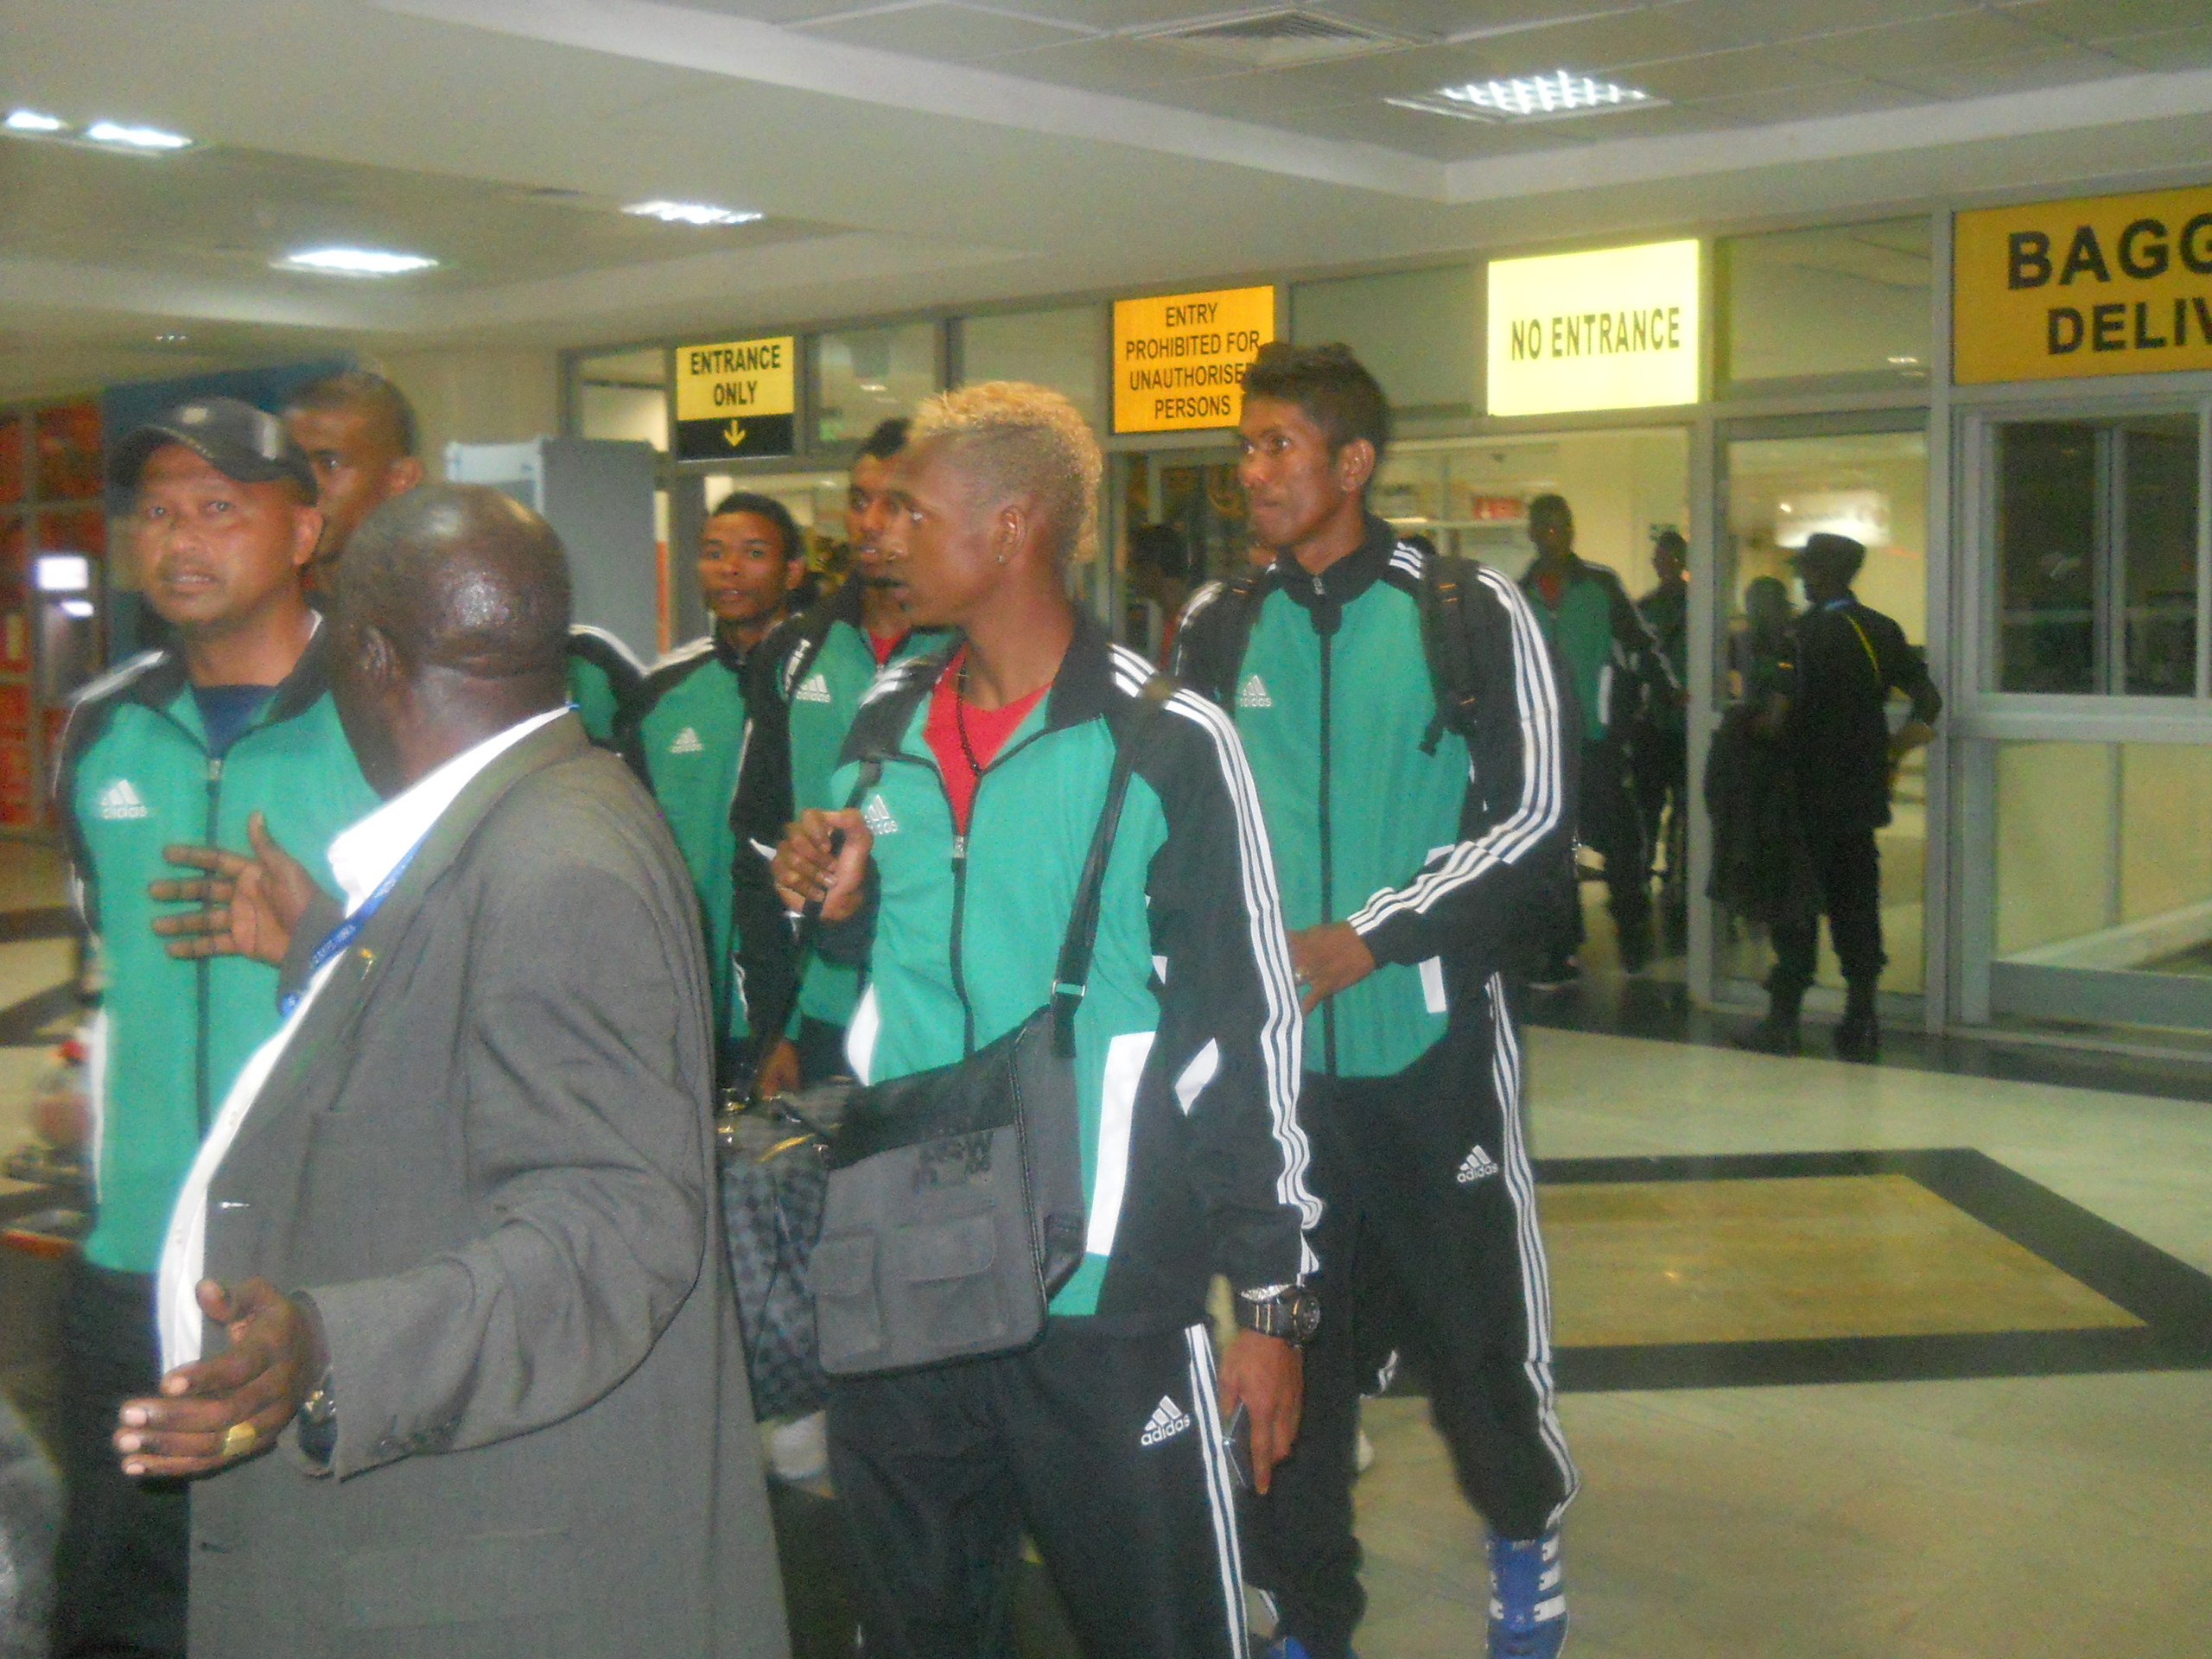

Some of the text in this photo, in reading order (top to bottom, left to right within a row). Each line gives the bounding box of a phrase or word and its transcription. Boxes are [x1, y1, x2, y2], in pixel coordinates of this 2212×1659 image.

[1166, 302, 1218, 327] ENTRY
[1126, 330, 1261, 361] PROHIBITED FOR
[1512, 306, 1681, 361] NO ENTRANCE
[691, 345, 781, 376] ENTRANCE
[714, 380, 758, 407] ONLY
[1154, 395, 1231, 420] PERSONS
[1456, 1163, 1499, 1183] adidas
[1141, 1414, 1191, 1446] adidas
